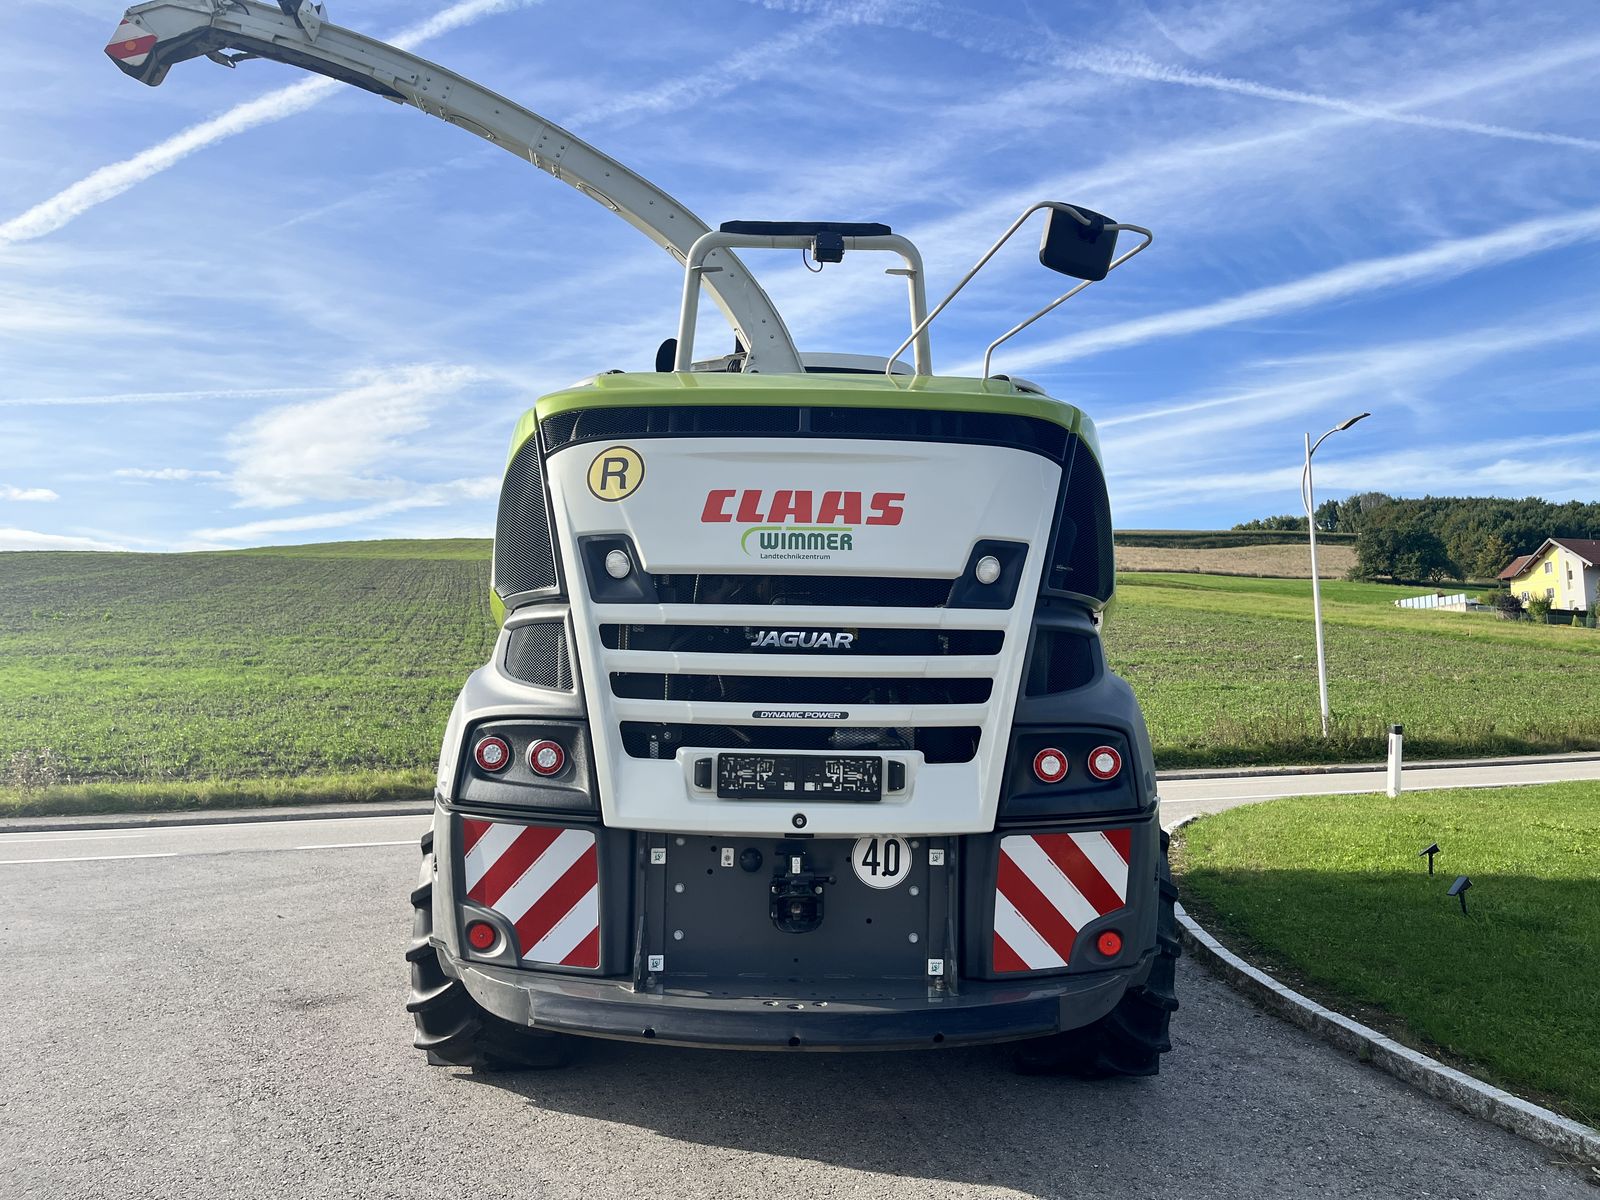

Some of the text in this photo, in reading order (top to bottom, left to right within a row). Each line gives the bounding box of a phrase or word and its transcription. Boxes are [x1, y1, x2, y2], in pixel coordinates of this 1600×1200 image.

[600, 457, 629, 490] R
[701, 489, 906, 526] CLAAS
[759, 532, 853, 551] WIMMER
[750, 630, 854, 649] JAGUAR
[760, 711, 842, 719] DYNAMIC POWER
[861, 838, 901, 877] 40
